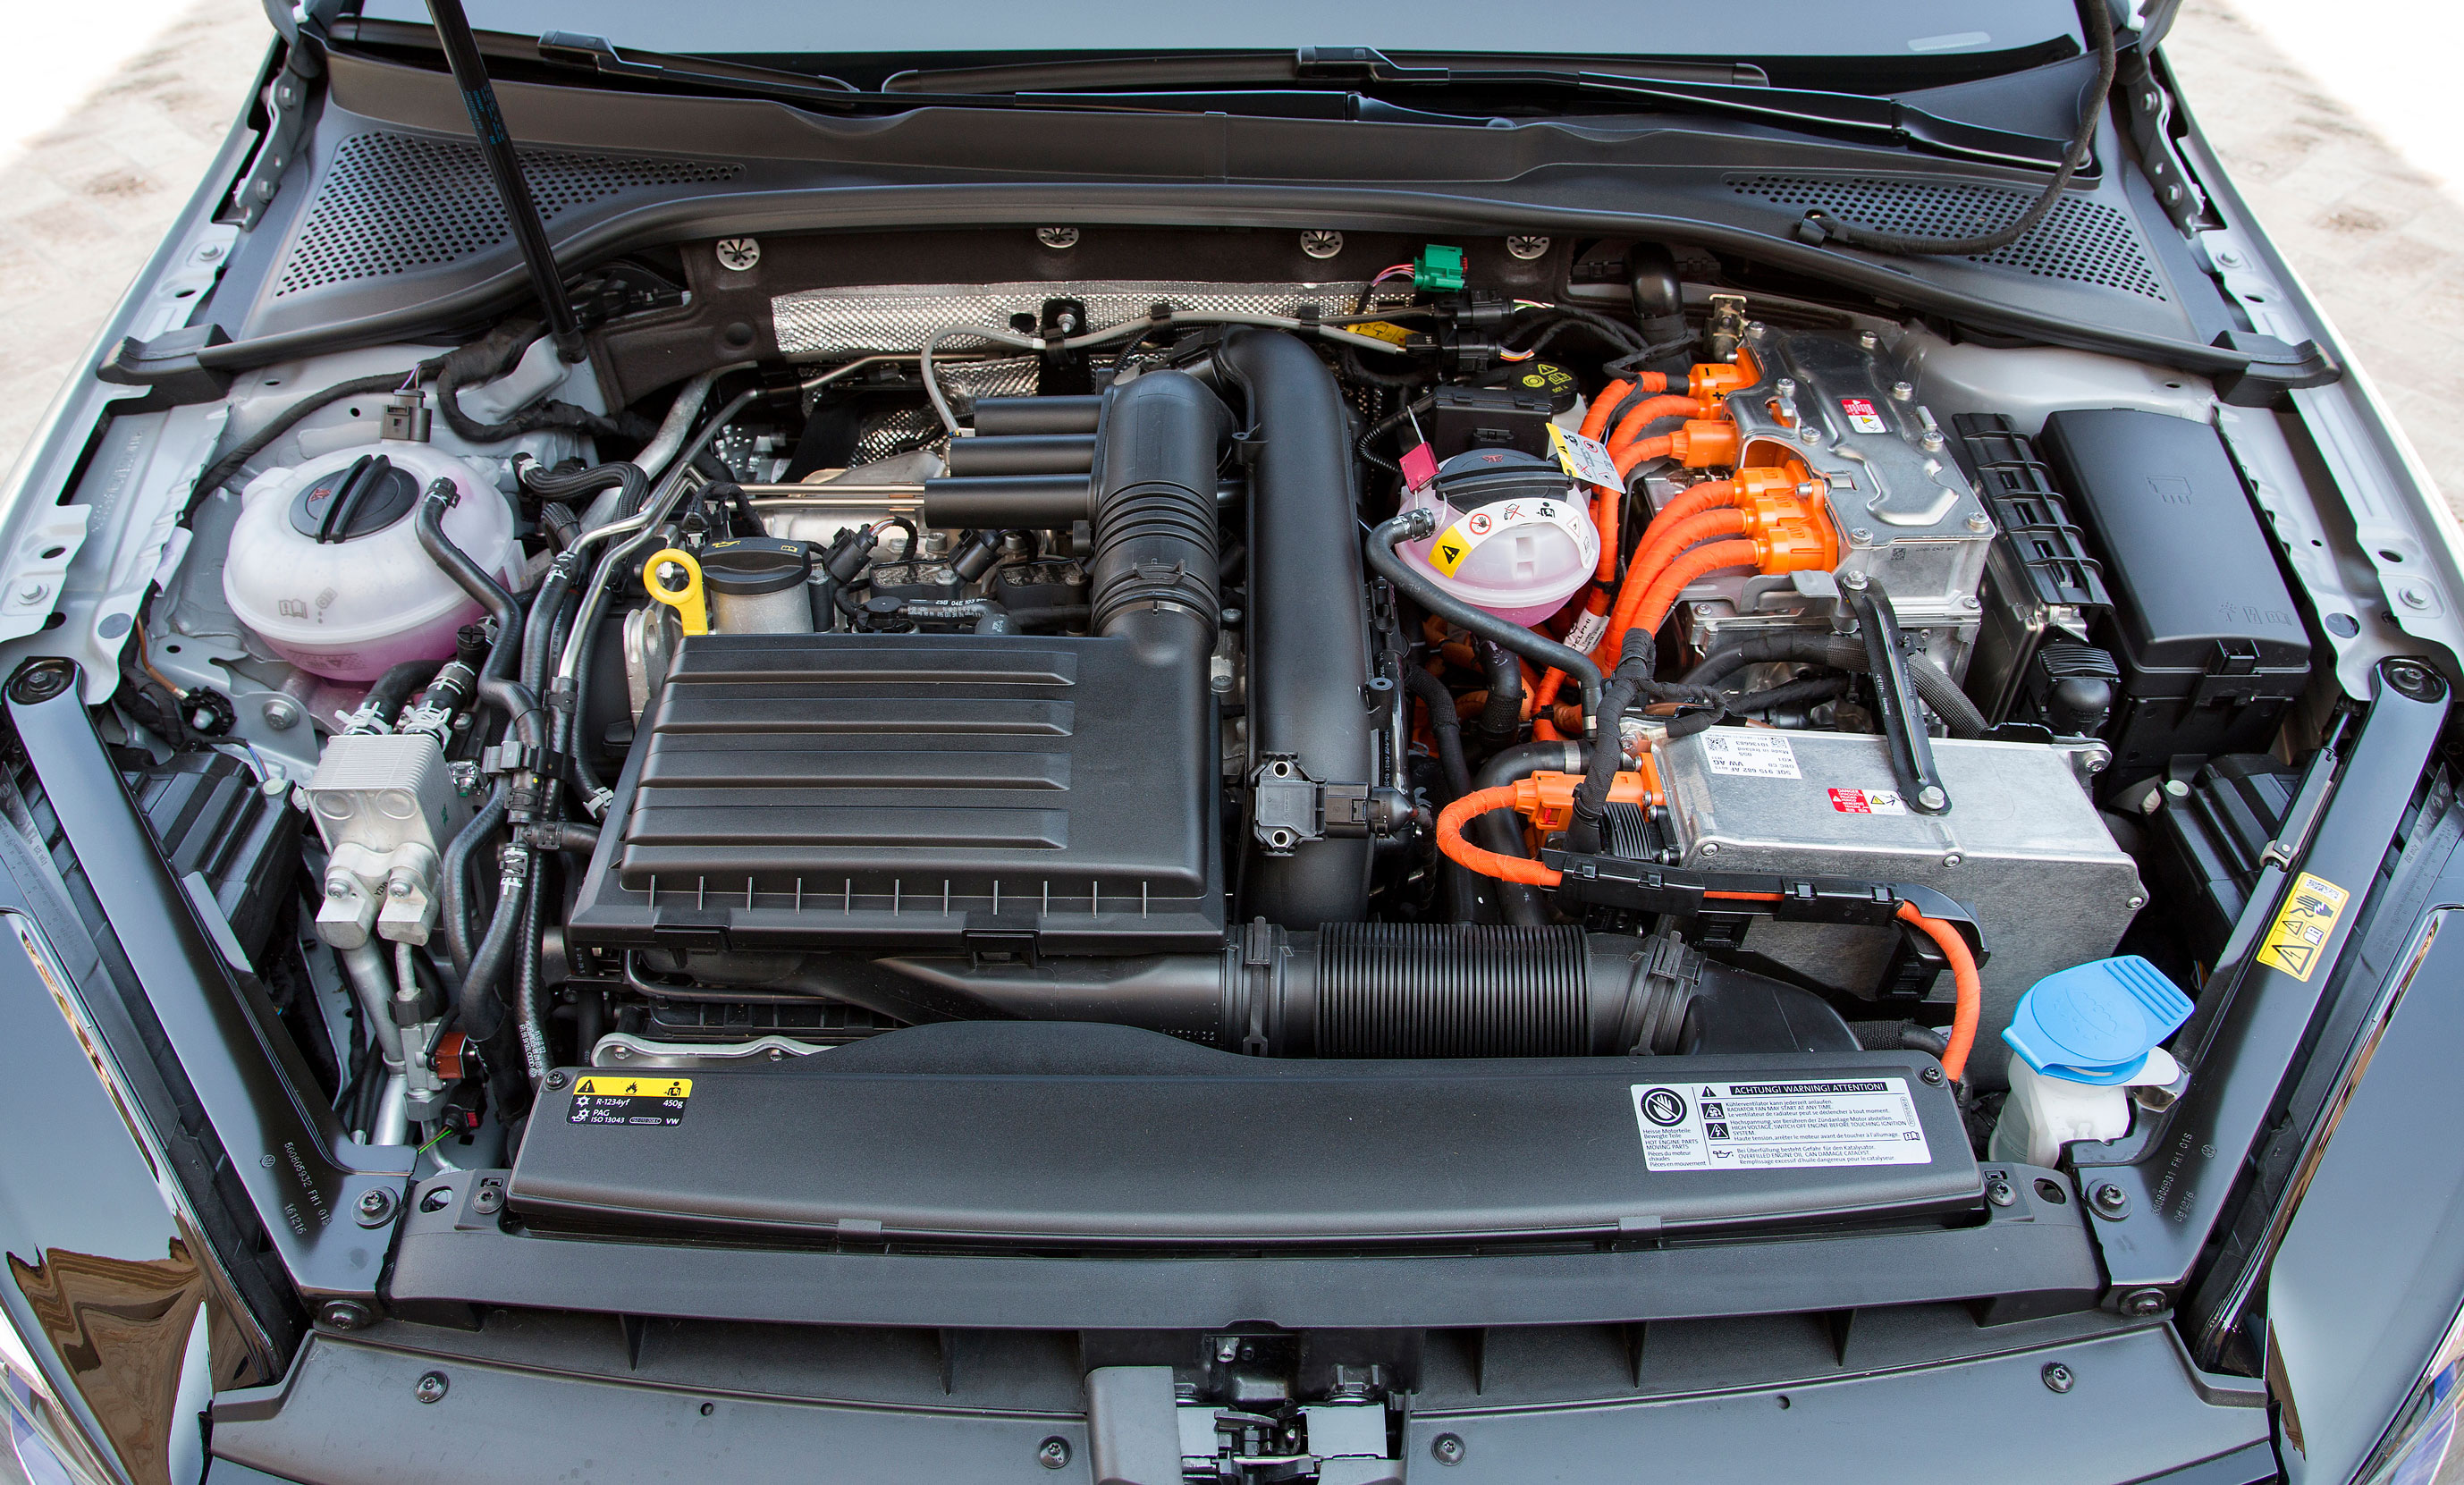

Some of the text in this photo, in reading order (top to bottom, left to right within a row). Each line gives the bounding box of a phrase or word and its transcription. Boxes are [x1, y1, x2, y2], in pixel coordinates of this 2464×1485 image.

[1734, 1086, 1782, 1094] ACHTUNG!
[1832, 1083, 1885, 1092] ATTENTION!
[596, 1099, 684, 1109] R-1234yf 450g
[1785, 1101, 1807, 1109] jederzeit
[2172, 1152, 2184, 1168] FH1
[2180, 1133, 2192, 1149] 01S
[285, 1142, 312, 1187] 5G0805932
[308, 1189, 322, 1206] FH1
[285, 1203, 307, 1235] 161216
